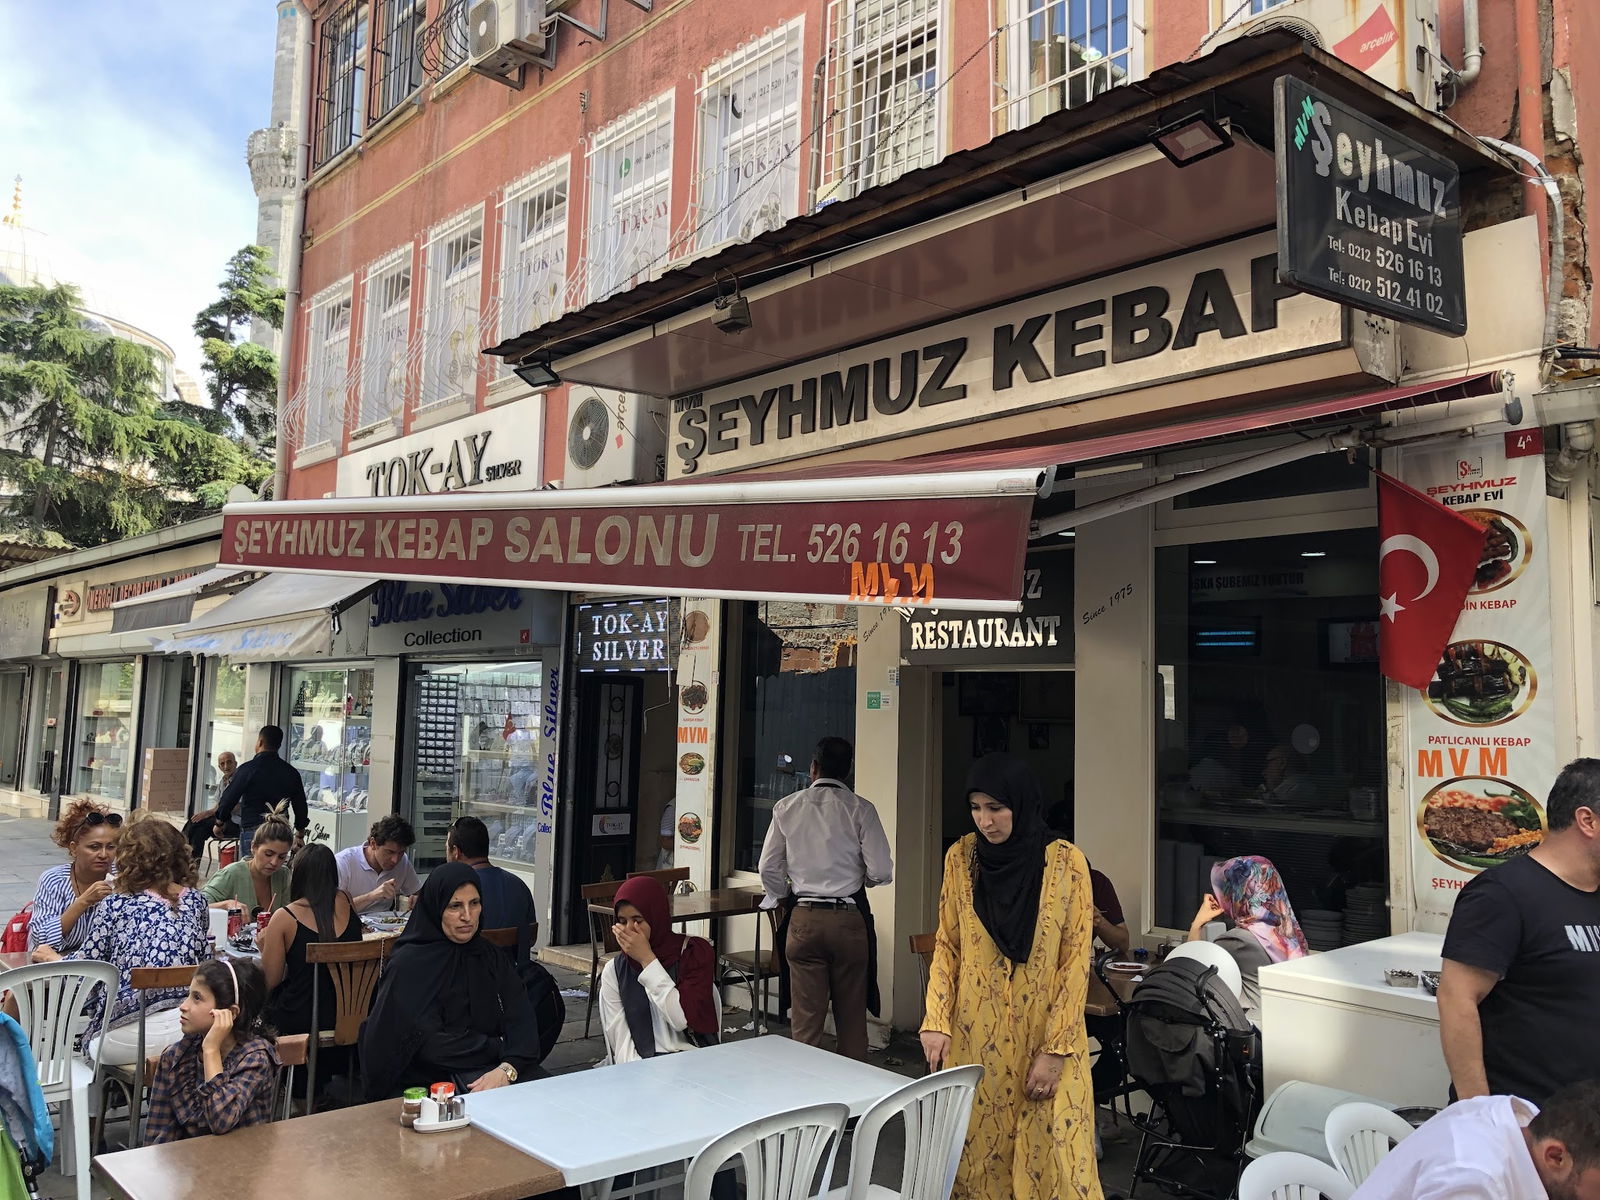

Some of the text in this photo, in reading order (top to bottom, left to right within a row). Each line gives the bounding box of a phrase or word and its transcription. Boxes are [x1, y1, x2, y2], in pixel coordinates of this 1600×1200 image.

[1360, 31, 1395, 53] arçelik
[1311, 101, 1447, 219] Şeyhmuz
[1335, 186, 1433, 258] Kebap Evi
[1327, 234, 1443, 288] Tel: 0212 526 16 13
[1327, 266, 1445, 316] Tel: 0212 512 41 02
[676, 337, 968, 474] ŞEYHMUZ
[366, 430, 522, 497] TOK-AY SILVER
[1426, 477, 1517, 497] ŞEYHMUZ
[1442, 493, 1480, 506] KEBAP
[234, 513, 964, 568] ŞEYHMUZ KEBAP SALONU TEL. 526 16 13
[1082, 583, 1133, 625] Since 1975
[1480, 599, 1517, 610] KEBAP
[404, 627, 482, 648] Collection
[592, 611, 668, 635] TOK-AY
[911, 615, 1060, 650] RESTAURANT
[592, 639, 665, 661] SILVER
[541, 667, 561, 817] Blue Silver
[677, 726, 708, 744] MVM
[1428, 735, 1531, 747] PATLICANLI KEBAP
